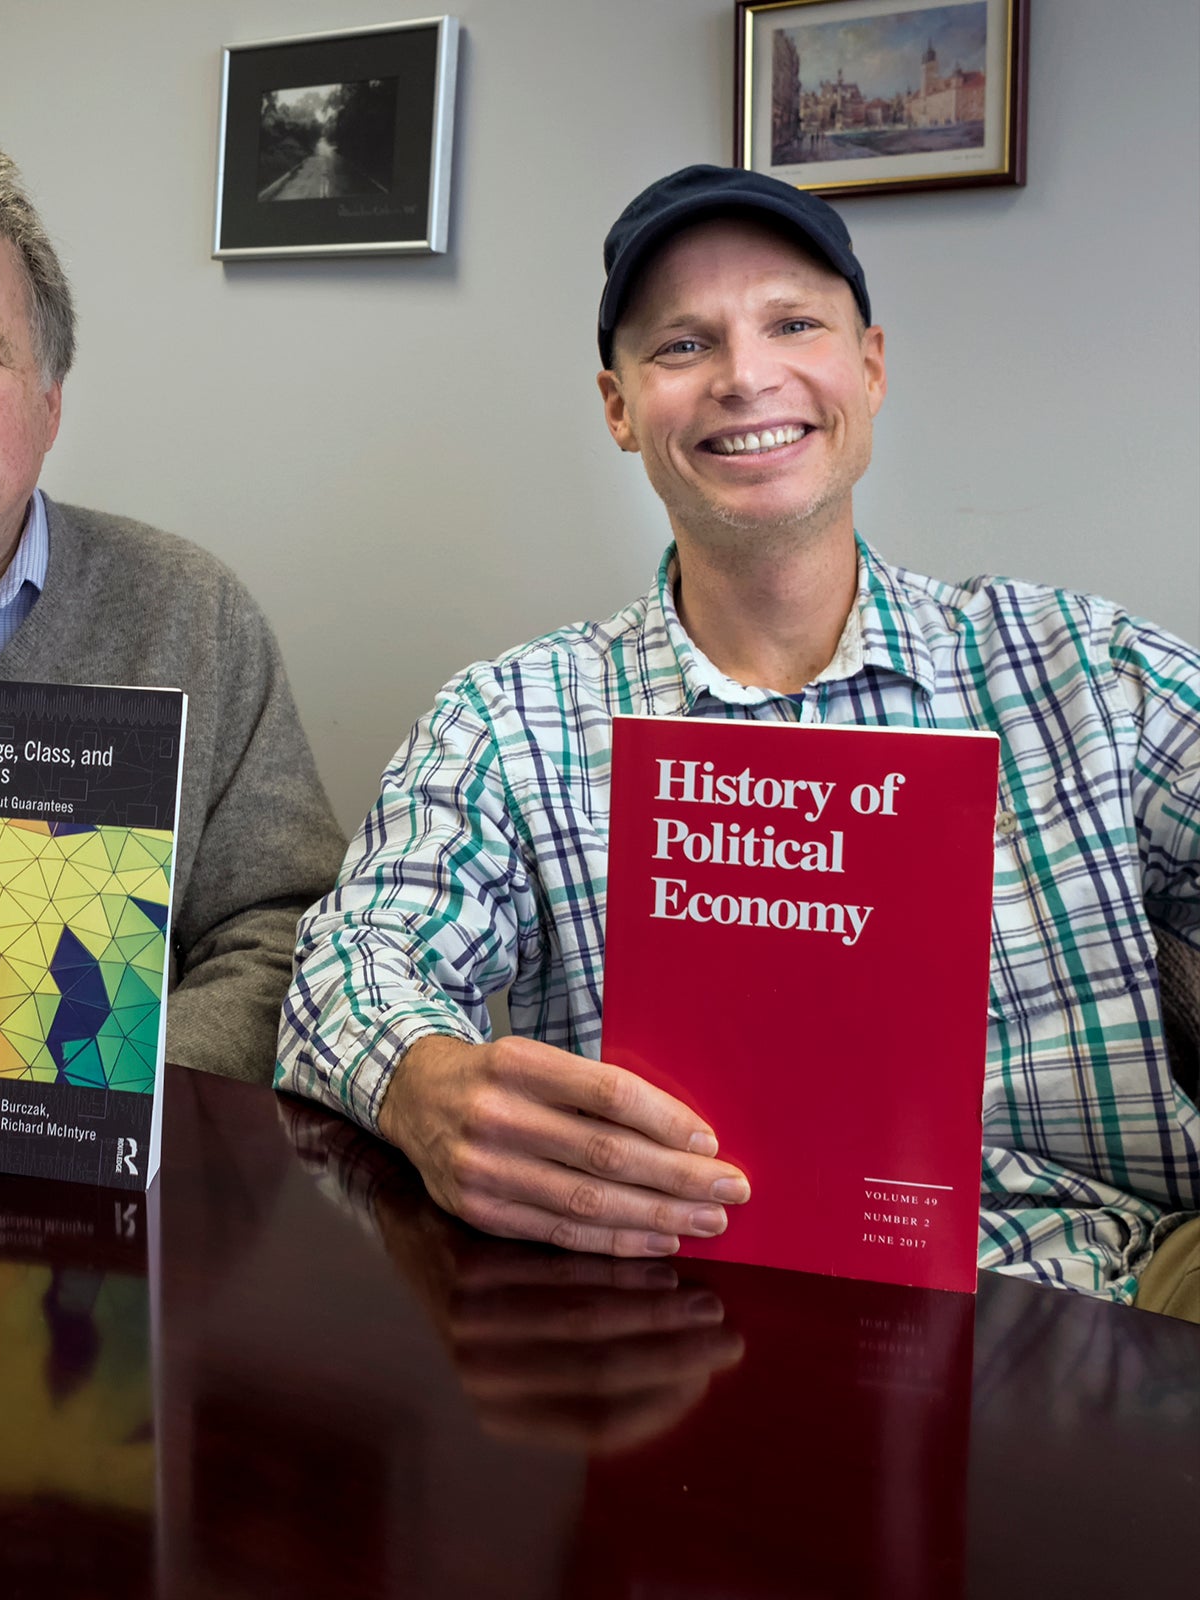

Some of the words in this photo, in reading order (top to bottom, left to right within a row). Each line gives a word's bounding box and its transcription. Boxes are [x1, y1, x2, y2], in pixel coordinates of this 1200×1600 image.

[24, 740, 75, 768] Class,
[81, 746, 113, 767] and
[654, 758, 836, 822] History
[850, 772, 905, 815] of
[11, 796, 74, 814] Guarantees
[651, 817, 845, 872] Political
[649, 876, 874, 946] Economy
[1, 1099, 50, 1119] Burczak,
[0, 1117, 43, 1135] Richard
[46, 1123, 97, 1142] McIntyre
[115, 1137, 125, 1174] ROUTLEDGE
[864, 1190, 919, 1205] VOLUME
[923, 1197, 938, 1206] 49
[863, 1211, 918, 1226] NUMBER
[923, 1218, 930, 1228] 2
[862, 1233, 894, 1245] JUNE
[899, 1237, 927, 1249] 2017
